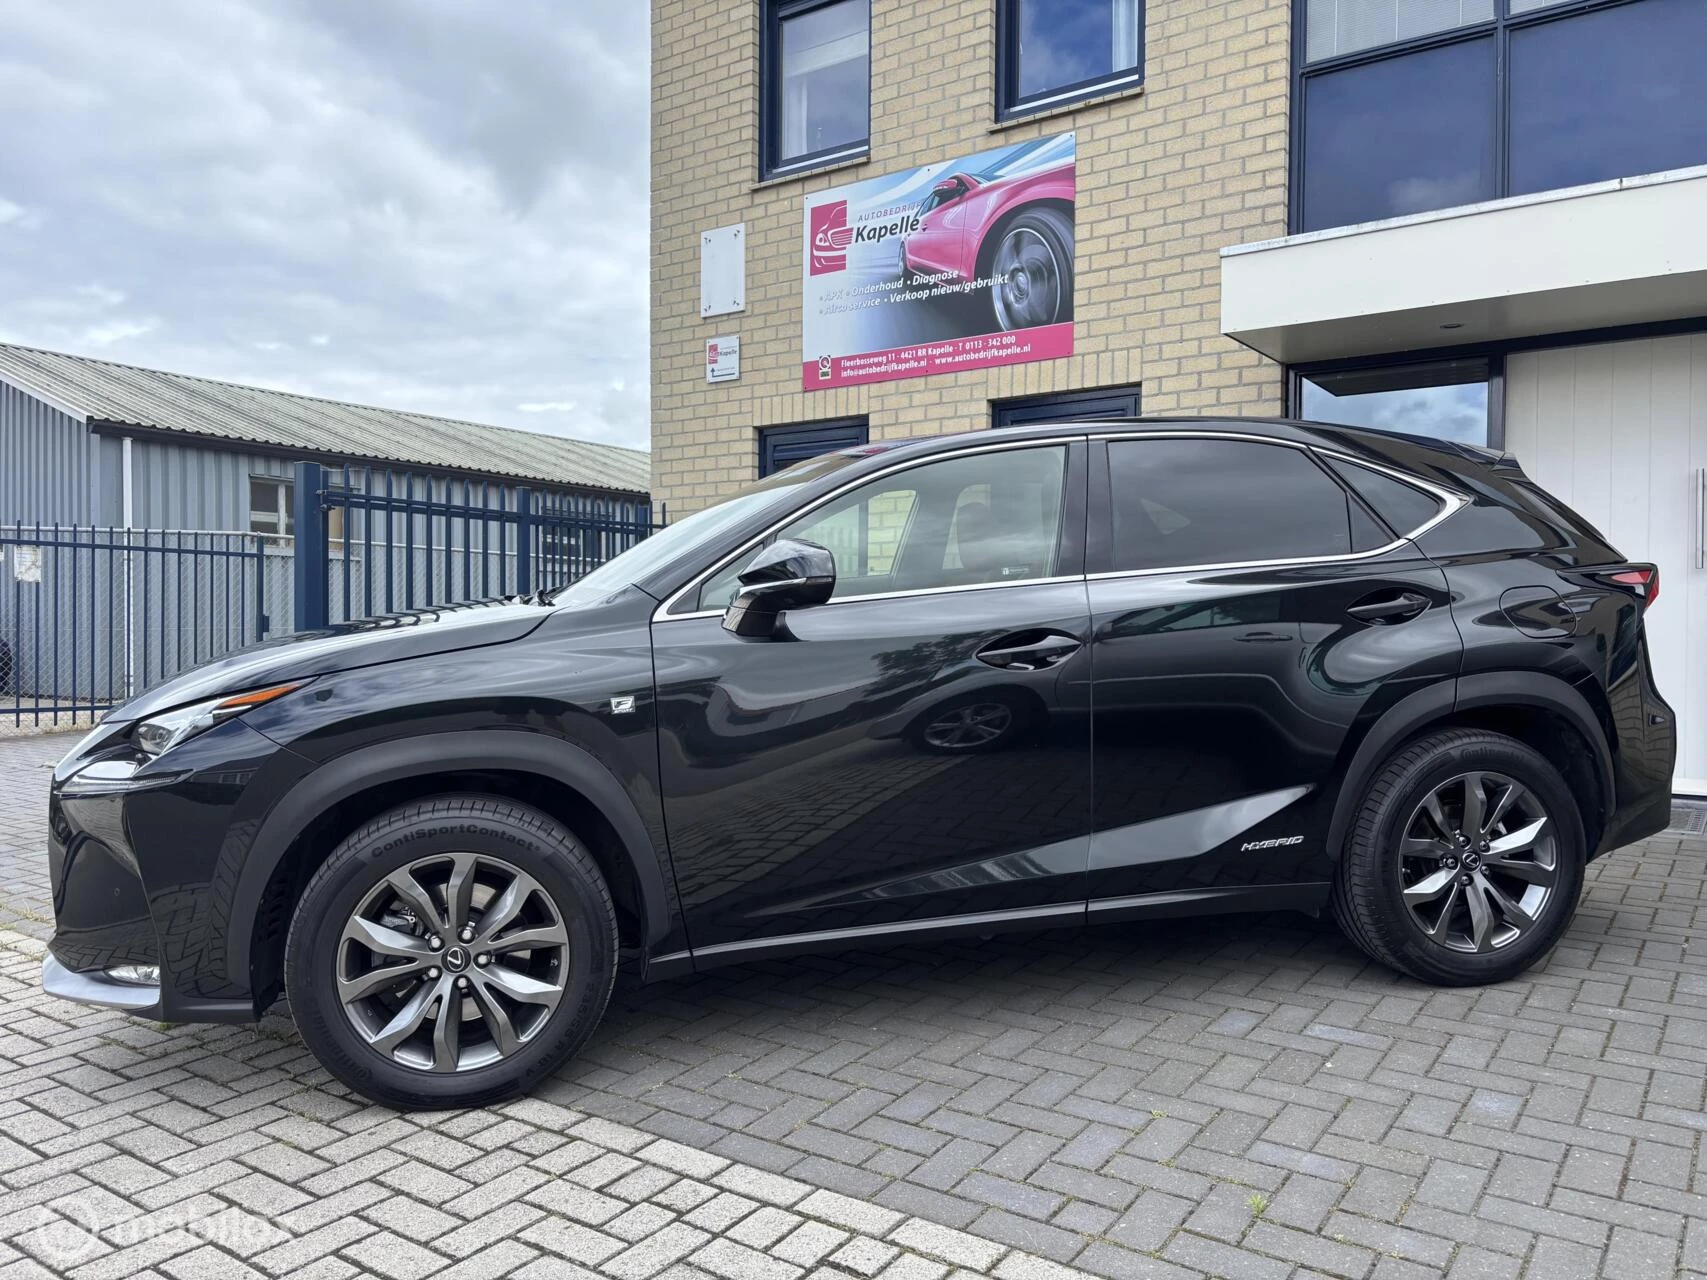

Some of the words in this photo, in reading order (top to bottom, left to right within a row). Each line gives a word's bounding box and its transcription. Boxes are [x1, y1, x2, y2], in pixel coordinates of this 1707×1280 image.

[855, 215, 920, 243] Kapelle
[851, 277, 904, 297] Onderhoud
[912, 270, 959, 286] Diagnose
[890, 289, 929, 303] Verkoop
[931, 274, 1009, 297] nieuw/gebruikt
[841, 359, 927, 377] info@autobedrijfkapelle.nl
[935, 344, 1031, 365] www.autobedrijfkapelle.nl
[888, 353, 895, 361] 11
[900, 350, 916, 359] 4421
[917, 348, 927, 357] RR
[928, 345, 953, 356] Kapelle
[965, 340, 982, 350] 0113
[988, 338, 1001, 347] 342
[1002, 335, 1016, 345] 000
[1240, 835, 1305, 852] HYBRID
